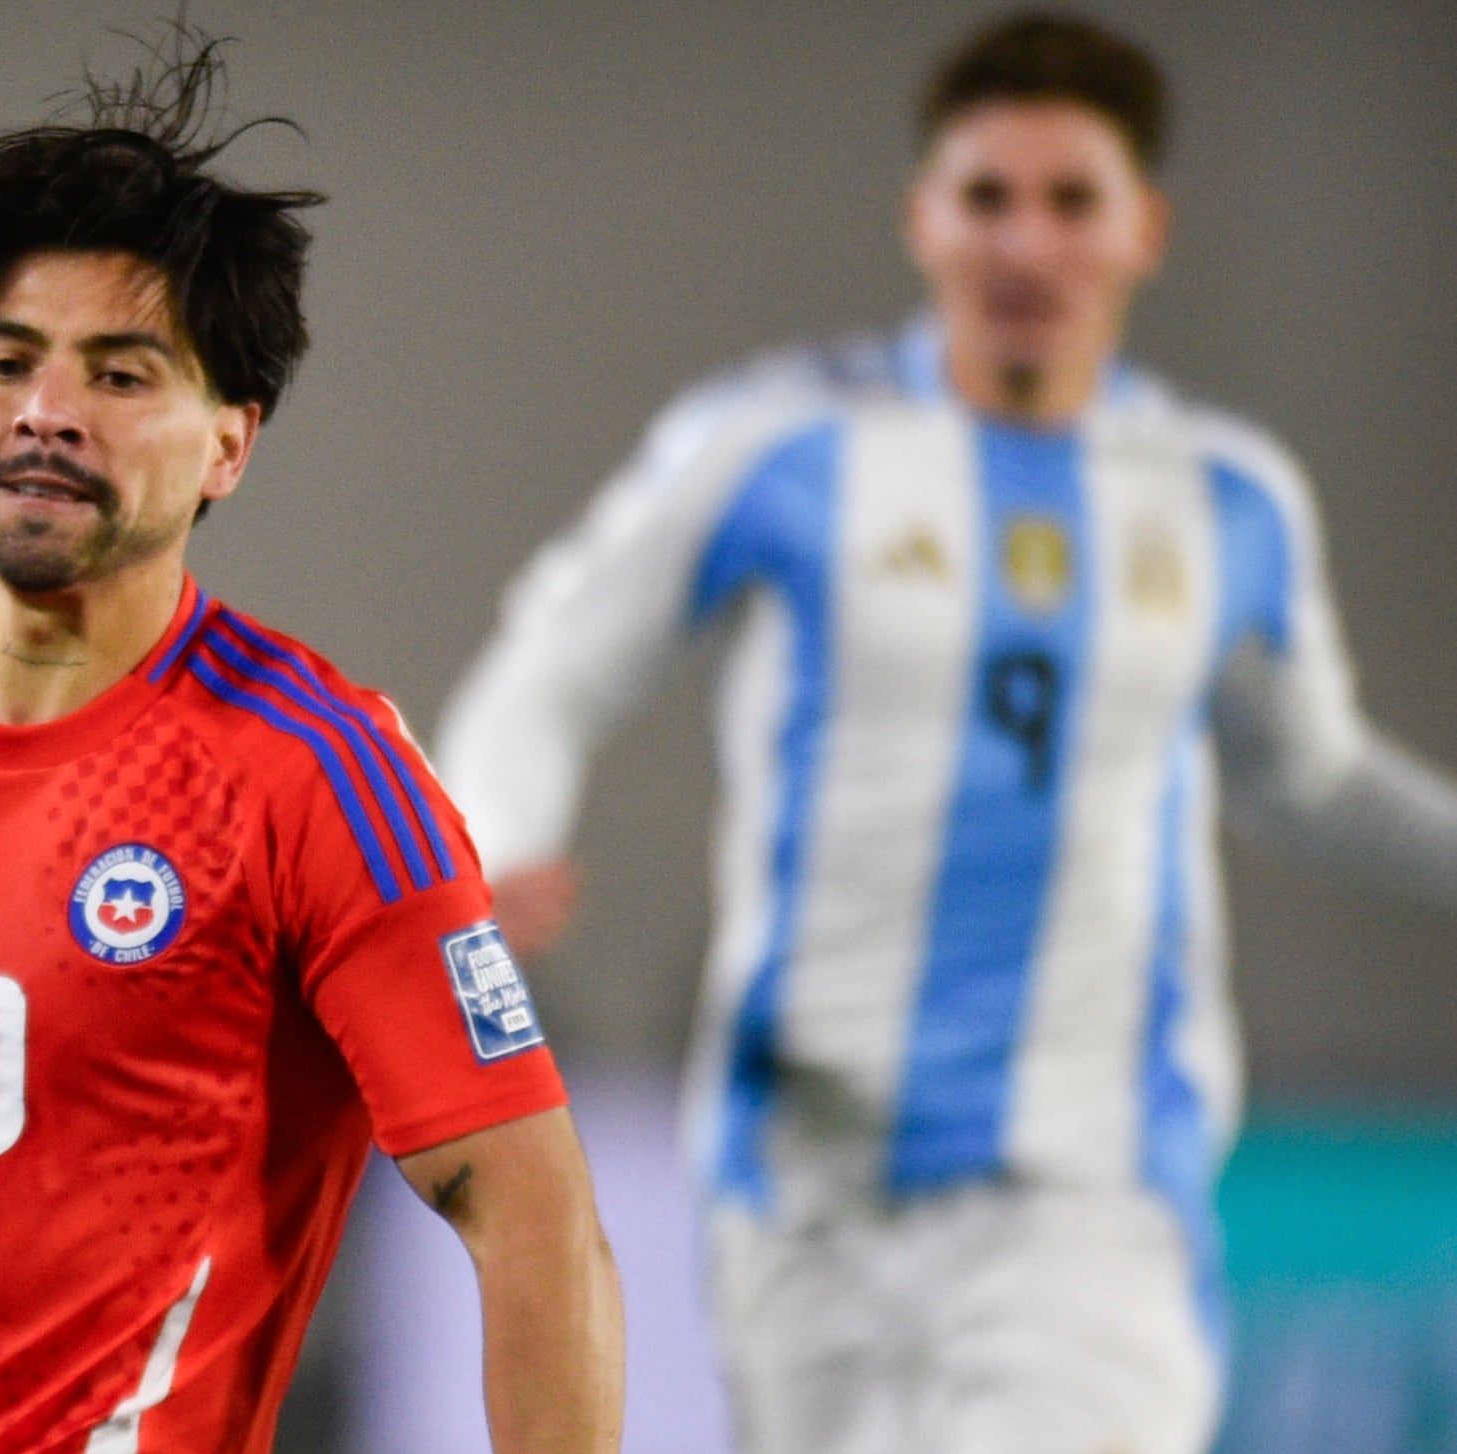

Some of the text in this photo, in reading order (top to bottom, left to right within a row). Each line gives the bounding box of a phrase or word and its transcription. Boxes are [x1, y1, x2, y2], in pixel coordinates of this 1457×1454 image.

[989, 650, 1057, 790] 9
[72, 846, 185, 912] FEDERACION DE FUTBOL
[89, 941, 153, 963] DE CHILE
